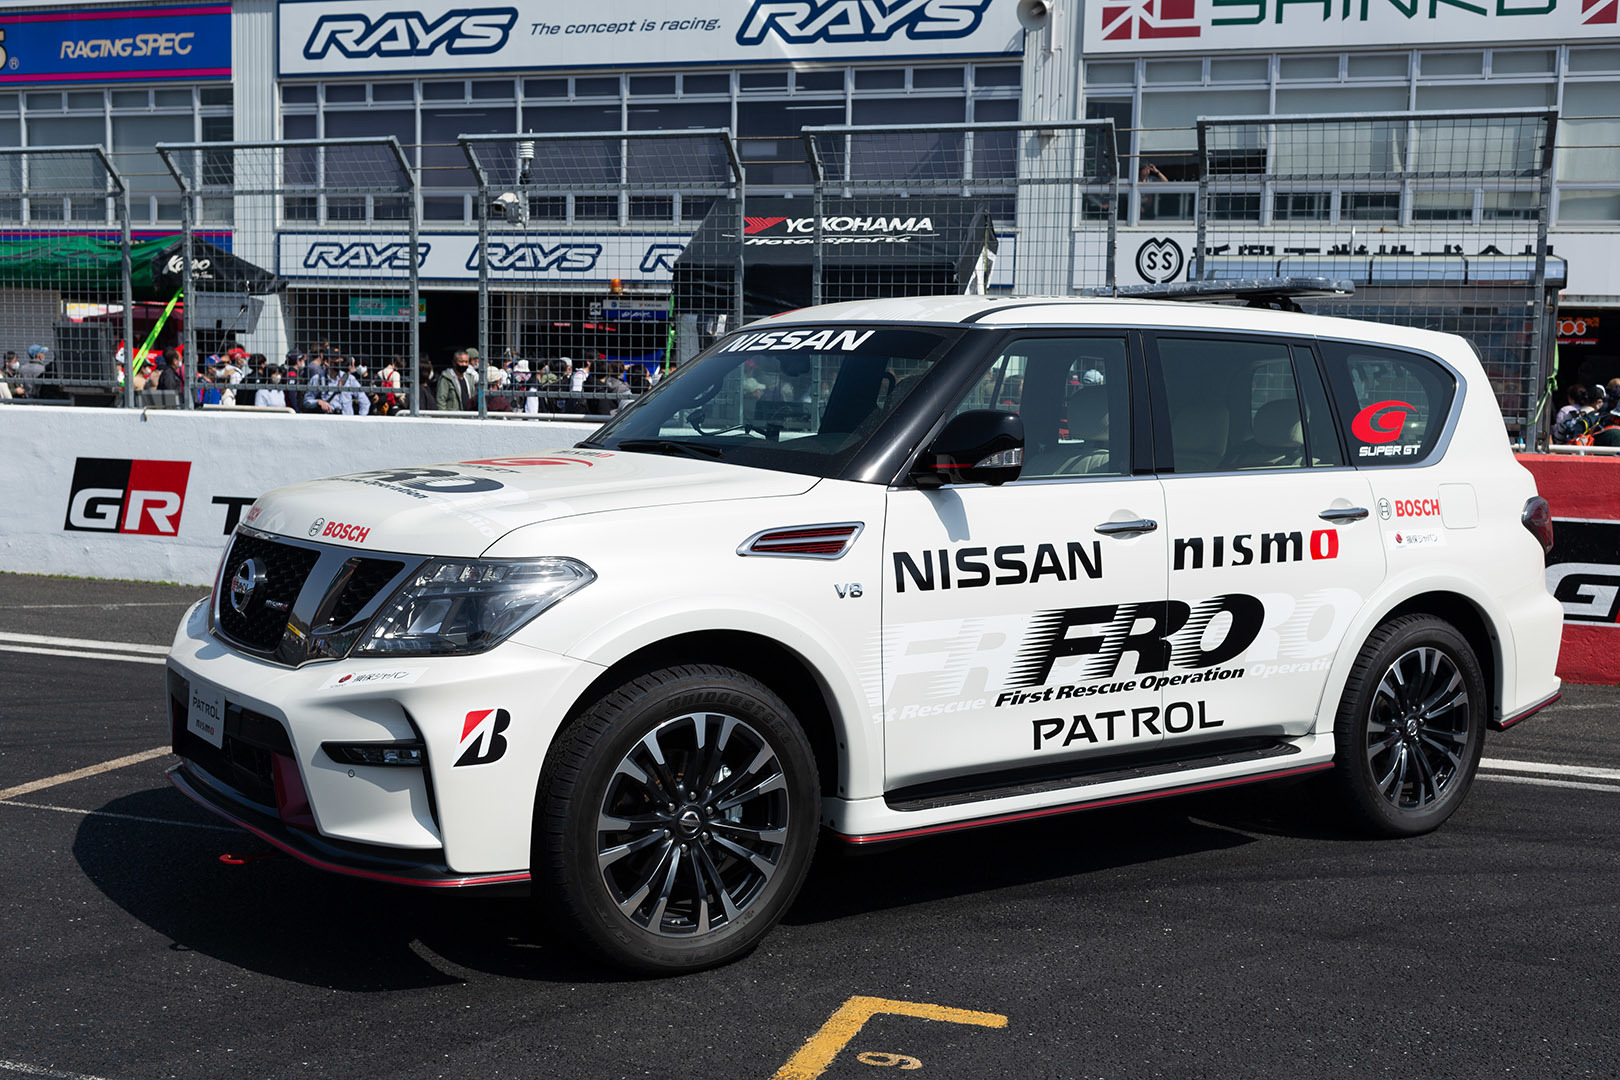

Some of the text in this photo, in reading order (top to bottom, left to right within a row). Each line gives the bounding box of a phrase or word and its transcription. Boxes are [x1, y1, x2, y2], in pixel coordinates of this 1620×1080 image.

[304, 7, 518, 59] RAYS
[530, 16, 722, 36] The concept is racing.
[736, 0, 992, 45] RAYS
[60, 32, 195, 59] RACING SPEC
[786, 217, 934, 234] YOKOHAMA
[304, 242, 431, 270] RAYS
[465, 243, 602, 272] RAYS
[719, 330, 875, 353] NISSAN
[1359, 444, 1421, 457] SUPER GT
[69, 487, 182, 533] GR
[1395, 499, 1441, 517] BOSCH
[322, 521, 371, 543] BOSCH
[1173, 529, 1340, 571] nismo
[892, 540, 1103, 593] NISSAN
[834, 583, 863, 599] V8
[1002, 593, 1265, 690] FRO
[995, 667, 1245, 709] First Rescue Operation
[192, 696, 220, 720] PATROL
[1032, 701, 1225, 750] PATROL
